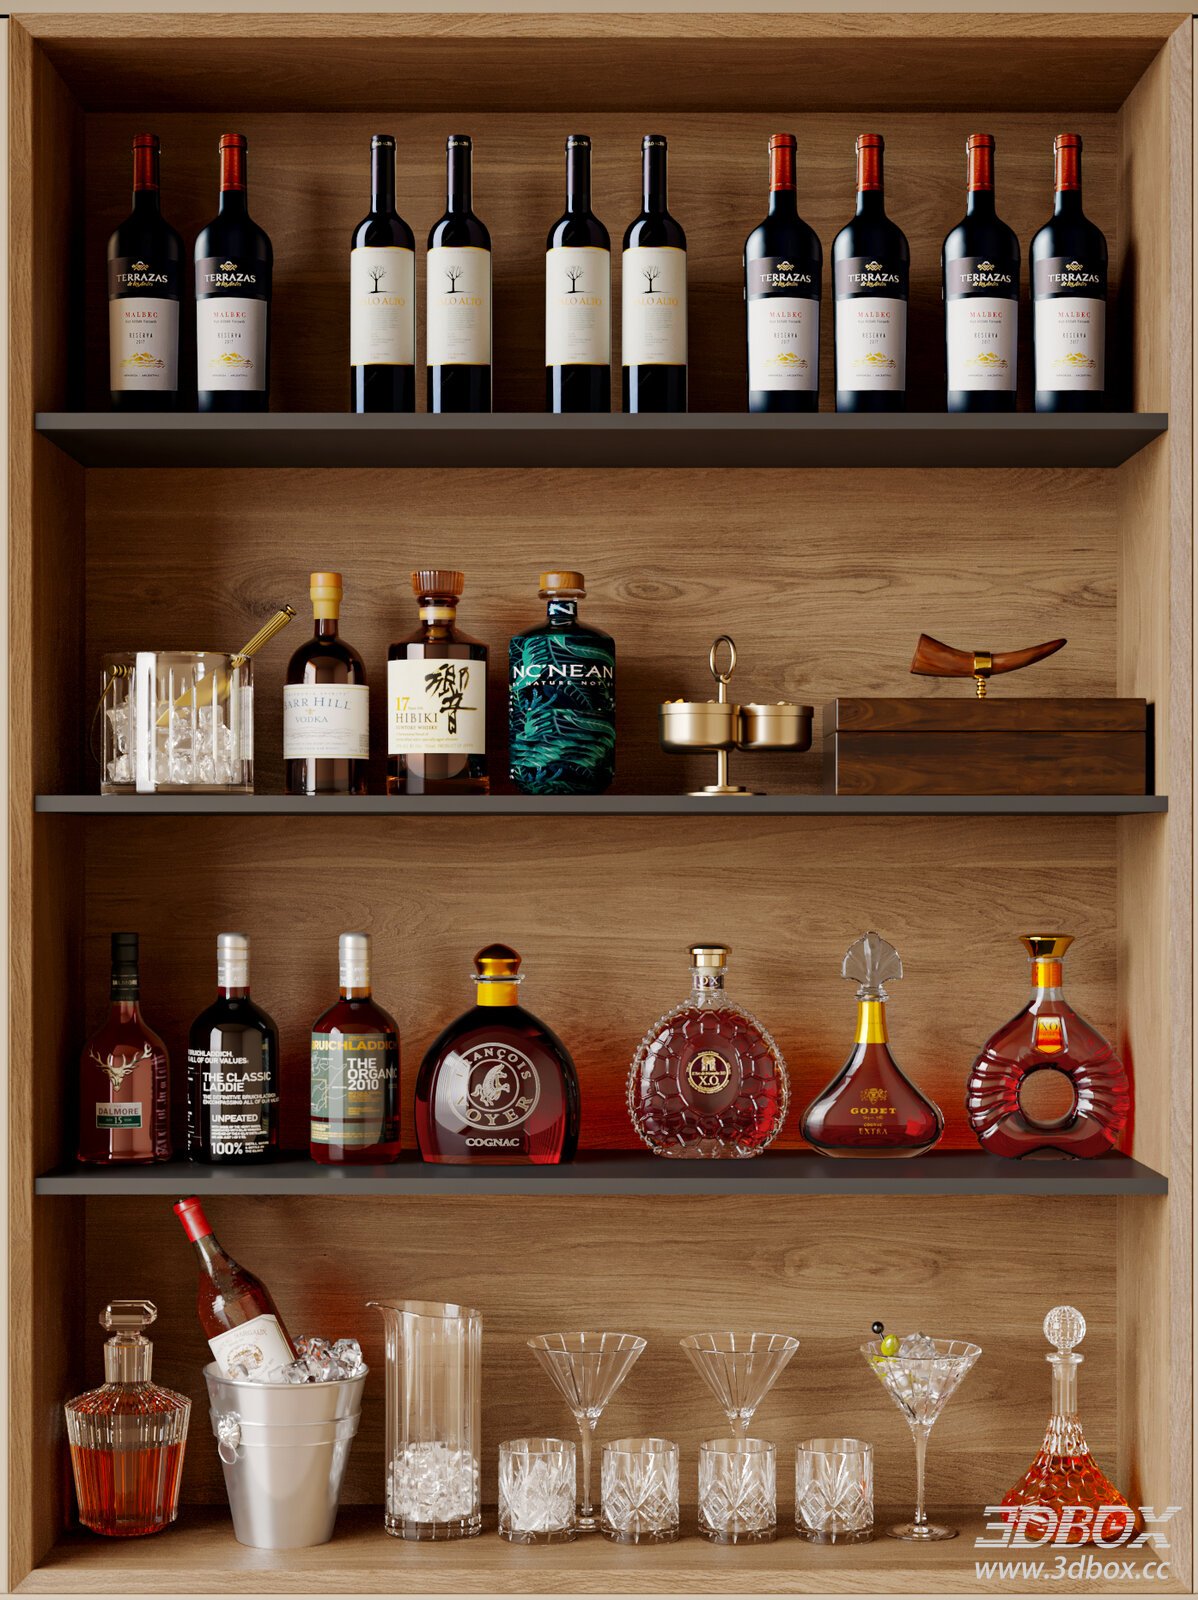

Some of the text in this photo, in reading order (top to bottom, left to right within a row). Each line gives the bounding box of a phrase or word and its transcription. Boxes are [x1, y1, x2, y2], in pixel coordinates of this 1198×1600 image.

[117, 273, 168, 283] TERRAZAS
[205, 273, 256, 283] TERRAZAS
[760, 273, 811, 283] TERRAZAS
[848, 273, 899, 283] TERRAZAS
[960, 273, 1011, 283] TERRAZAS
[1048, 273, 1099, 283] TERRAZAS
[314, 697, 351, 710] HILL
[396, 697, 409, 711] 17
[396, 713, 437, 723] HIBIKI
[347, 1058, 376, 1069] THE
[202, 1072, 271, 1082] THE CLASSIC
[203, 1083, 244, 1092] LADDIE
[348, 1080, 379, 1090] 2010
[212, 1114, 258, 1122] UNPEATED
[466, 1138, 519, 1147] COGNAC
[211, 1142, 243, 1155] 100%
